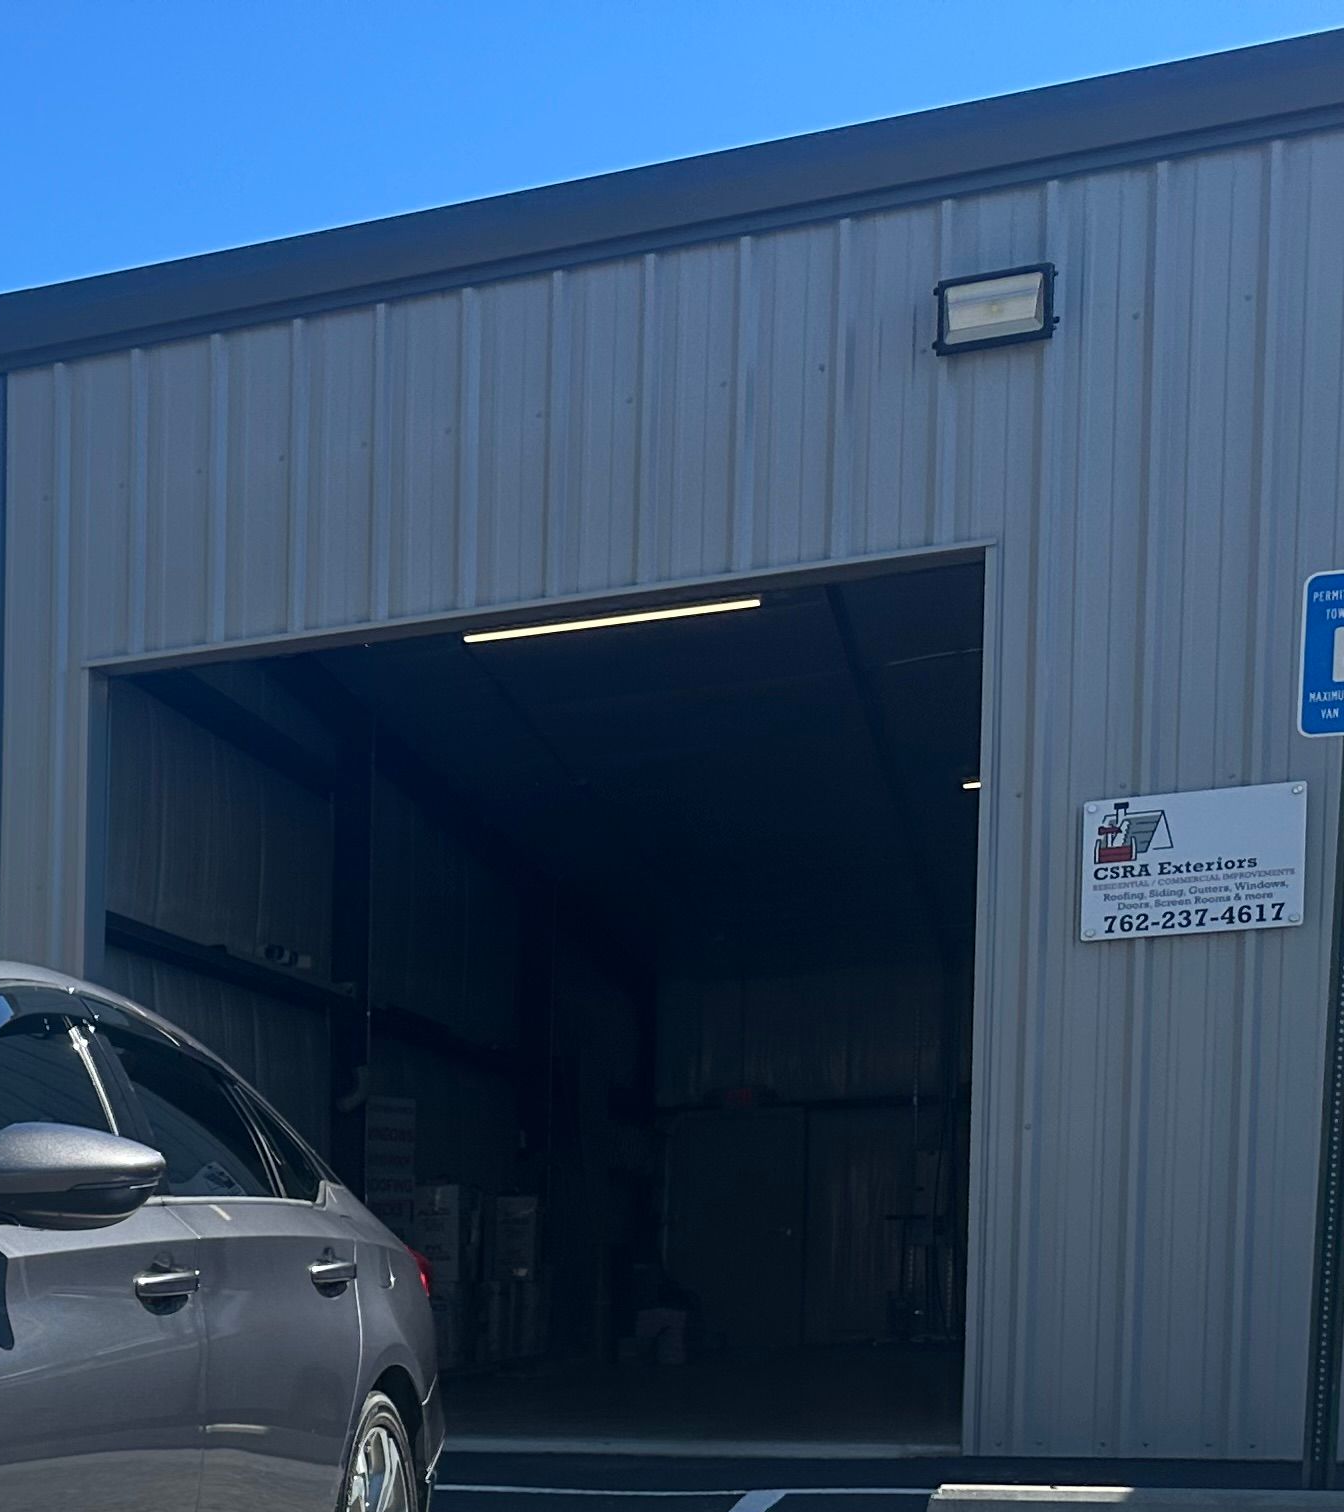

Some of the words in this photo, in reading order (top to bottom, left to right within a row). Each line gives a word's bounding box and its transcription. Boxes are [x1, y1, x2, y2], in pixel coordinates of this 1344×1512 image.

[1313, 589, 1344, 602] PERMI
[1321, 708, 1339, 719] VAN
[1094, 864, 1151, 880] CSRA
[1158, 856, 1257, 875] Exteriors
[1158, 874, 1221, 886] COMMERCIAL
[1104, 892, 1147, 902] Roofing,
[1149, 889, 1186, 898] Siding,
[1189, 886, 1232, 895] Gutters,
[1234, 880, 1289, 891] Windows,
[1117, 902, 1152, 911] Doors,
[1154, 898, 1191, 908] Screen
[1194, 895, 1231, 905] Rooms
[1233, 893, 1241, 901] &
[1245, 892, 1273, 901] more
[1104, 902, 1285, 934] 762-237-4617
